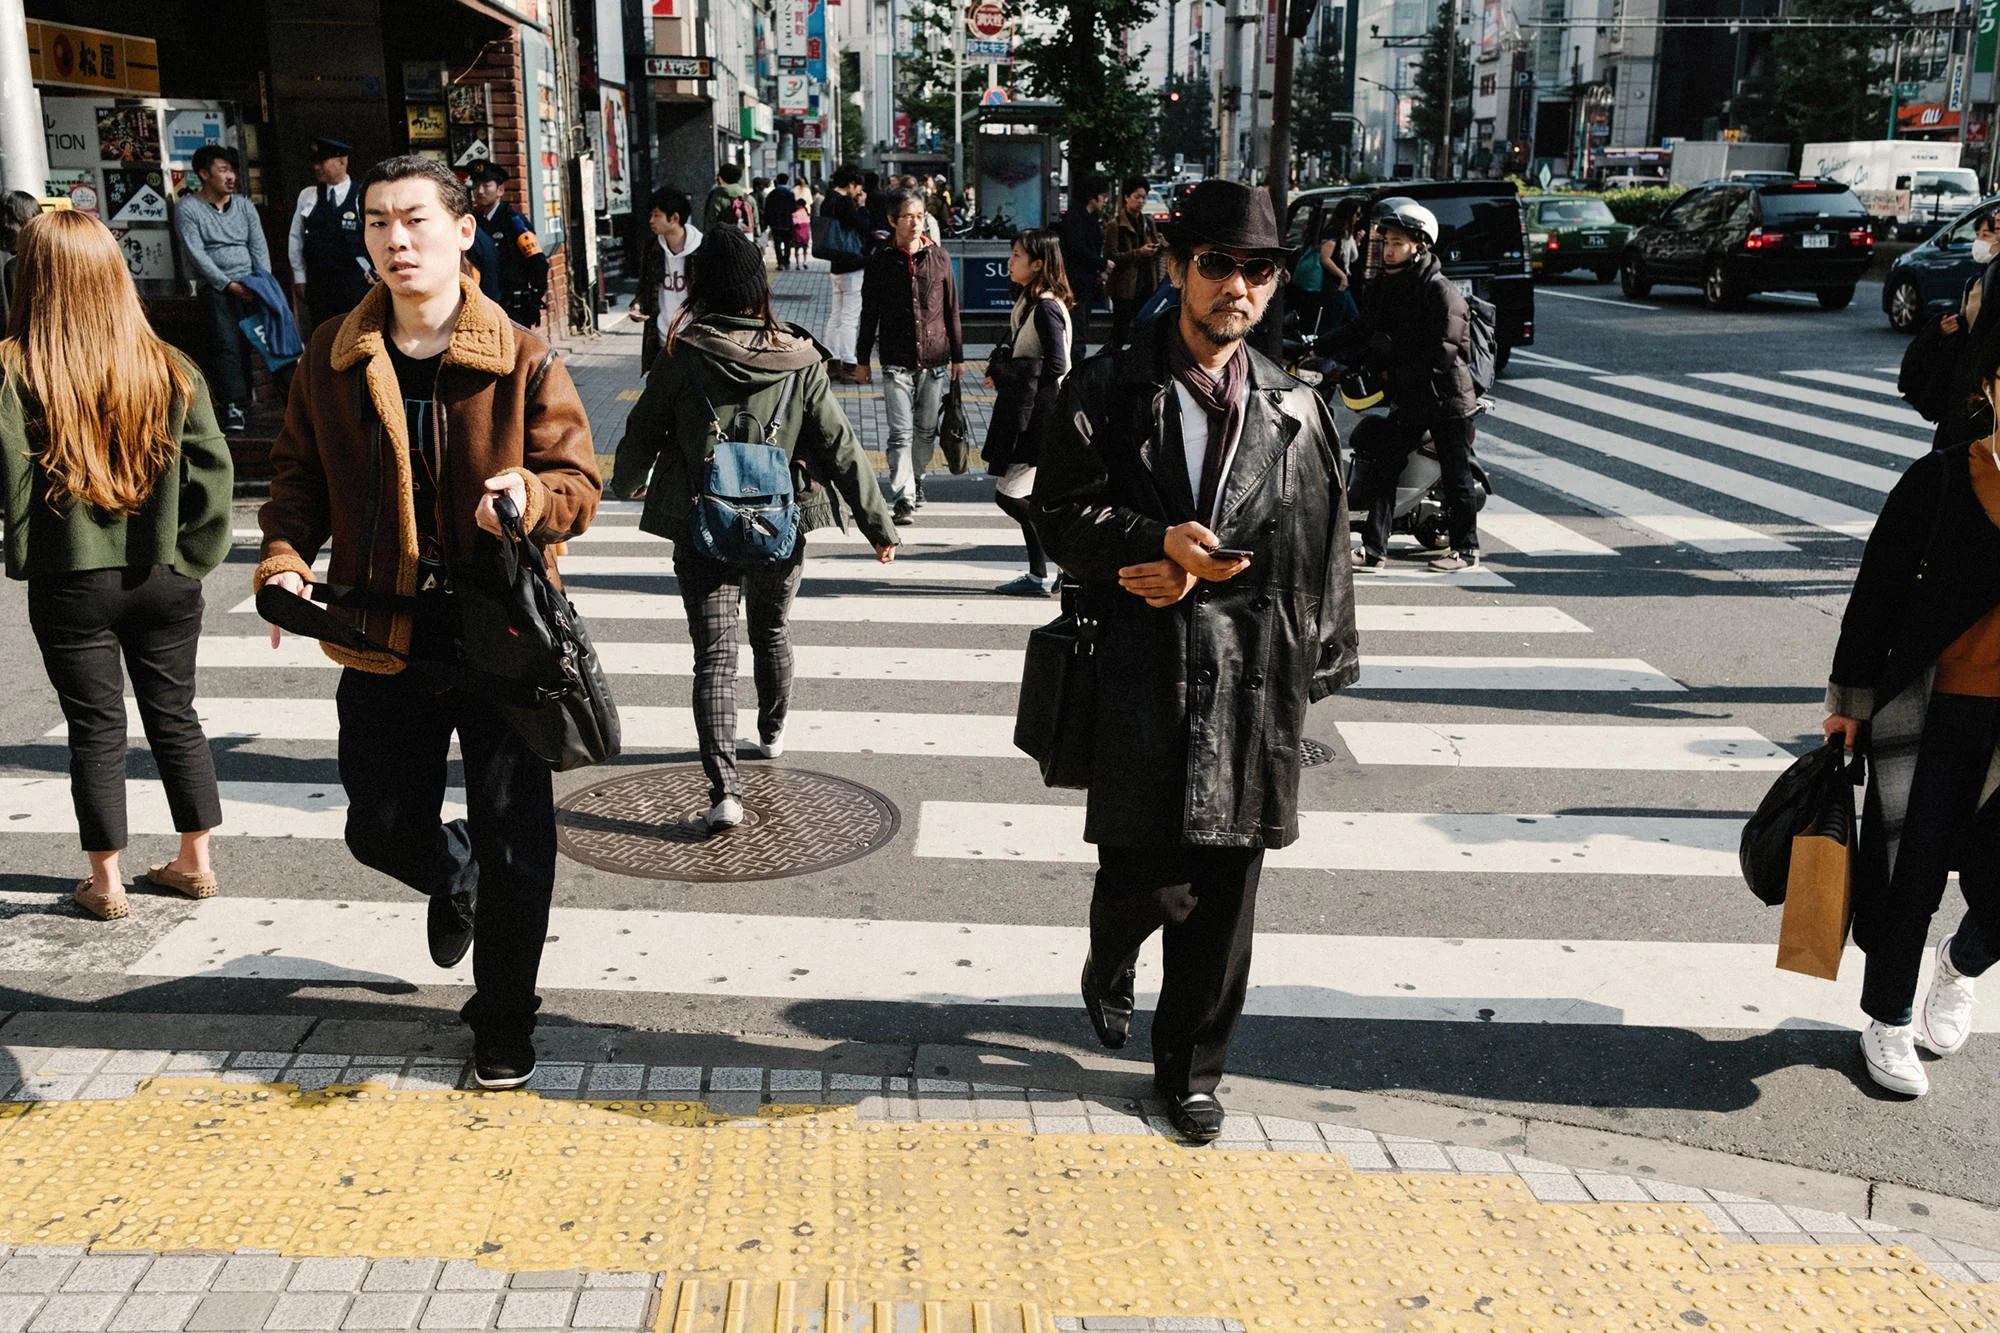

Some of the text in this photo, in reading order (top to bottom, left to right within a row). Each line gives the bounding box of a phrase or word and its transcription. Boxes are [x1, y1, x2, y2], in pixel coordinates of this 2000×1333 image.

[977, 12, 1003, 26] 消火栓
[78, 41, 117, 80] 松屋
[1921, 107, 1943, 125] au
